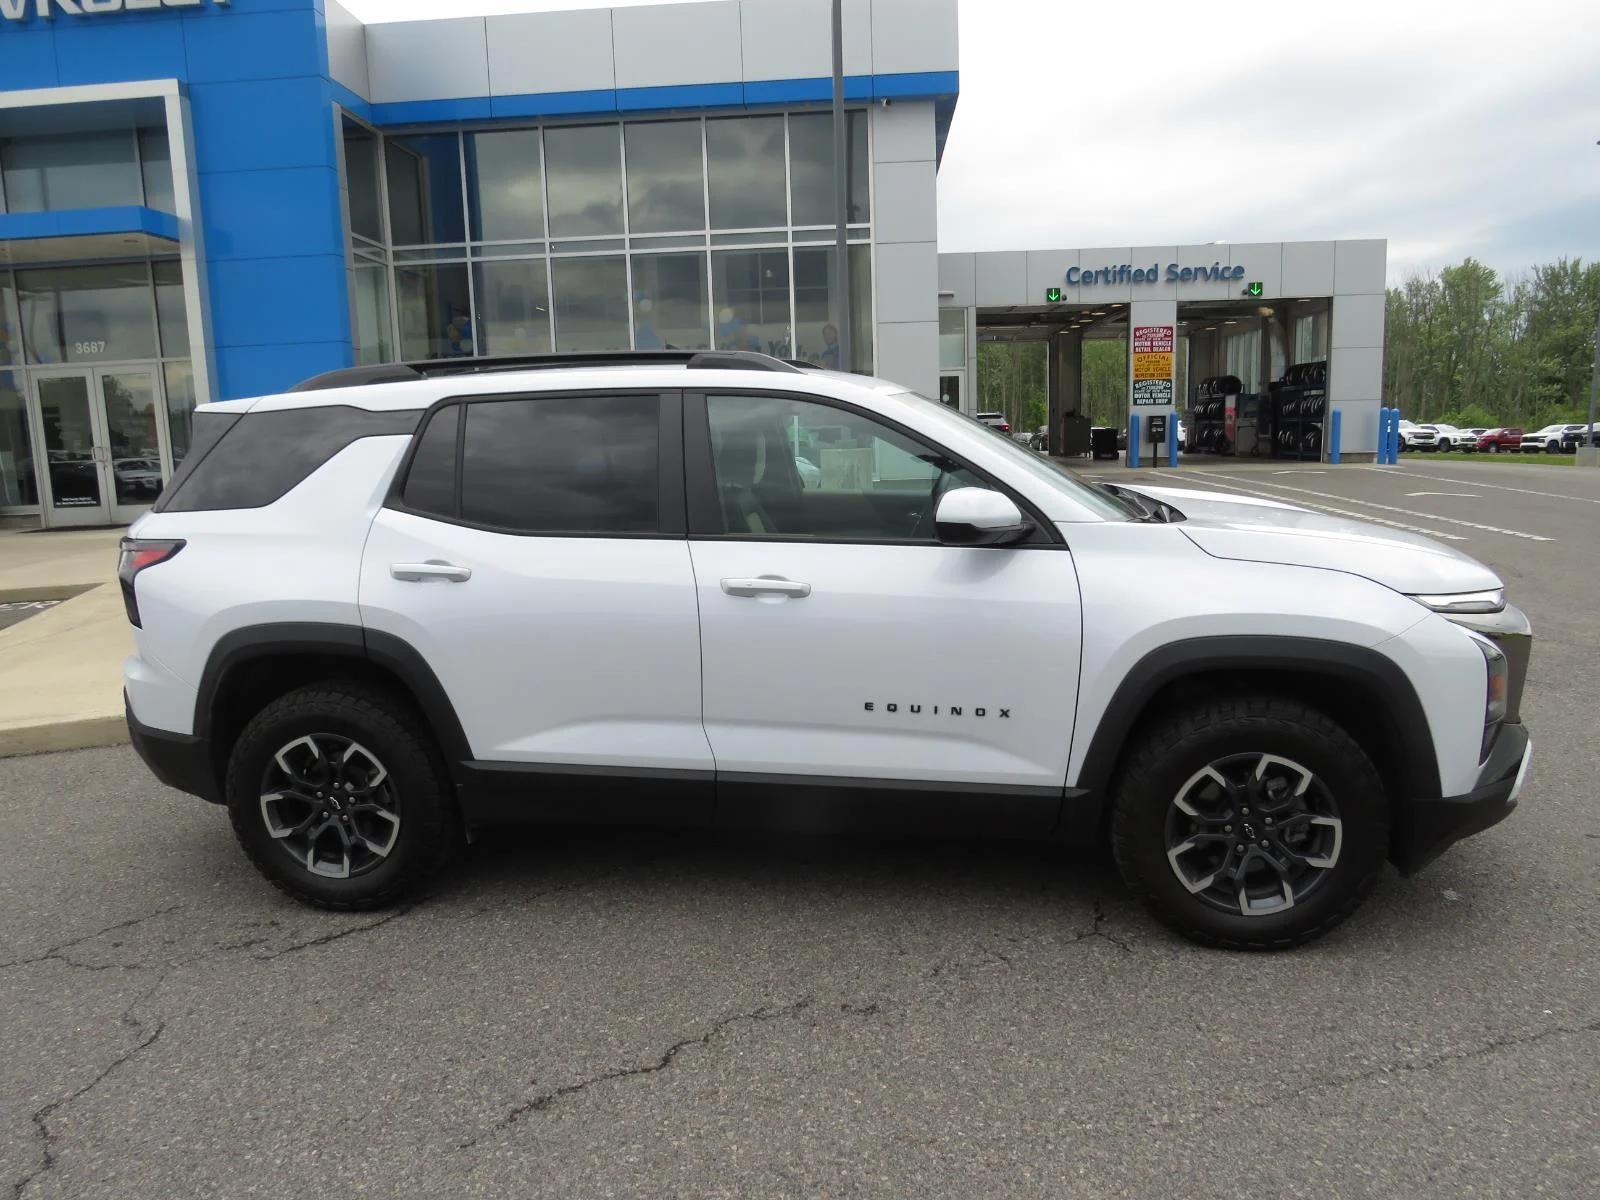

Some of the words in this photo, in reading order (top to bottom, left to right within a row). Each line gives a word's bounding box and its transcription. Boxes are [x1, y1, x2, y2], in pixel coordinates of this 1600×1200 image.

[1066, 263, 1159, 286] Certified
[1165, 262, 1245, 282] Service
[1135, 327, 1172, 337] REGISTERED
[75, 341, 105, 354] 3687
[1137, 354, 1169, 362] OFFICIAL
[1134, 380, 1171, 389] REGISTERED
[864, 702, 1010, 718] EQUINOX
